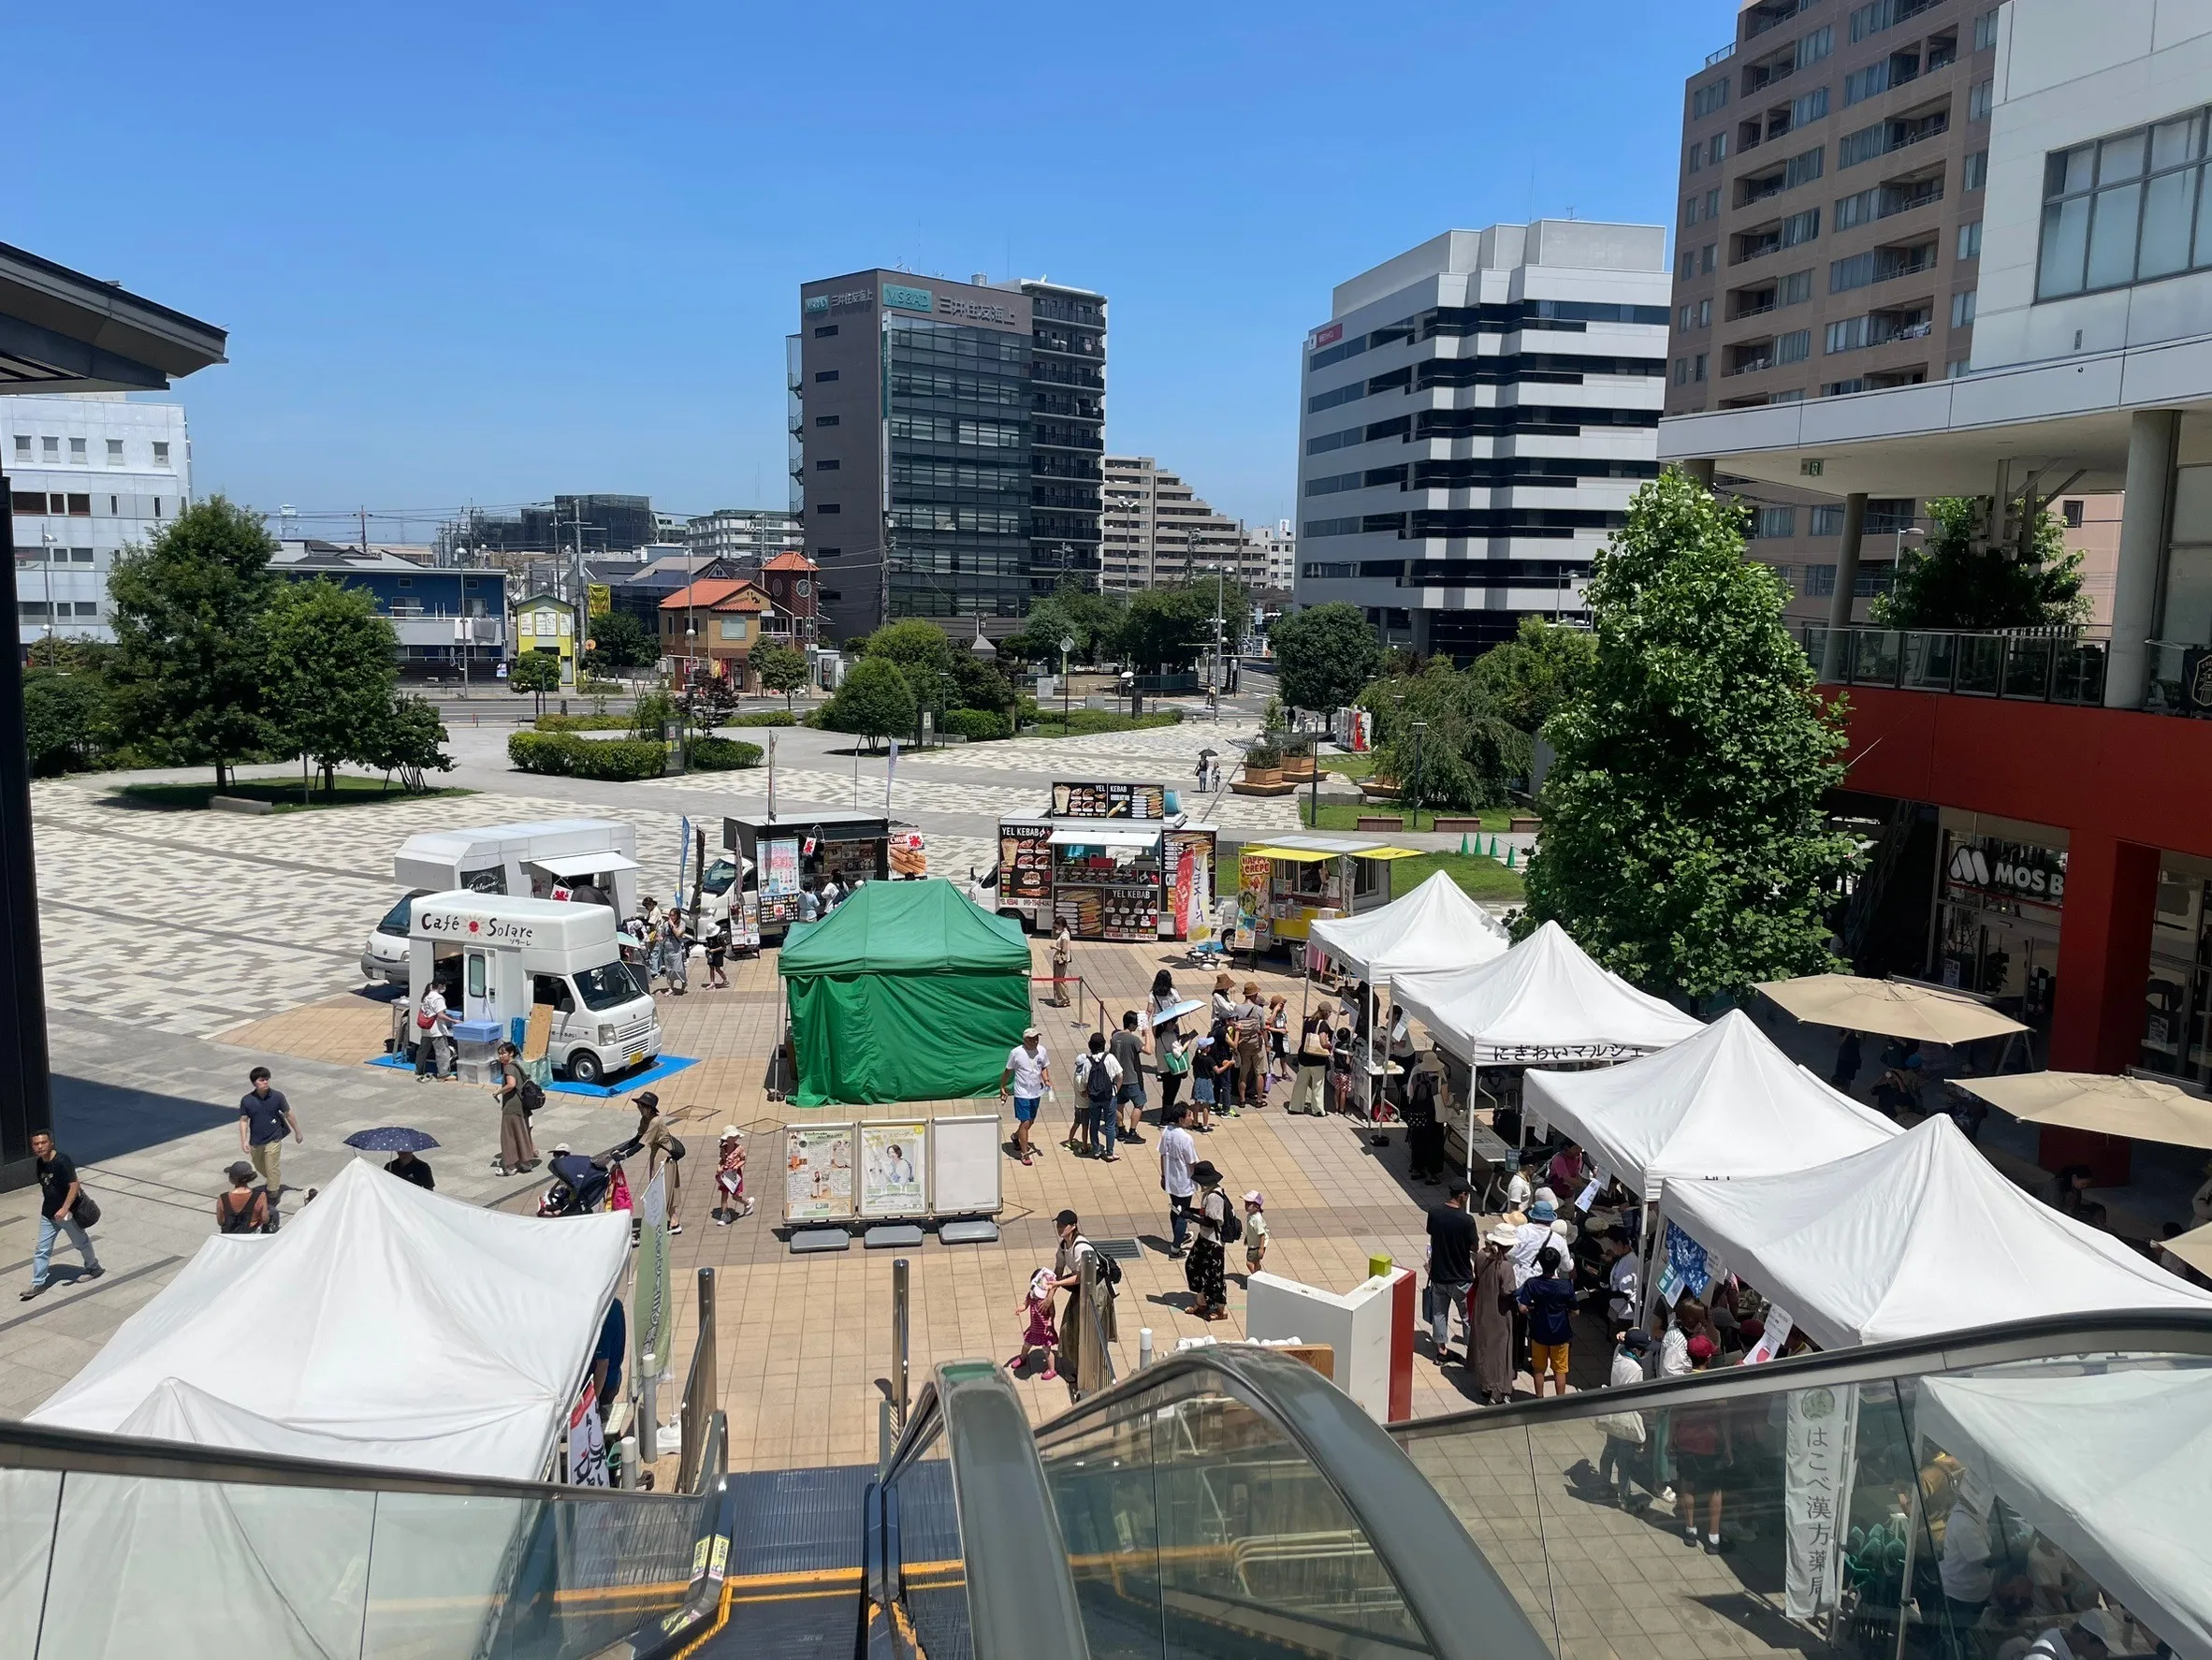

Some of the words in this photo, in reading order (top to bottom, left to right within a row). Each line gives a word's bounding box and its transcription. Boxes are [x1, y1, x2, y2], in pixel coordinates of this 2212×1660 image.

[831, 288, 873, 306] 三井住友海上
[887, 289, 929, 308] MS&AD
[939, 296, 1015, 326] 三井住友海上
[1001, 827, 1015, 836] YEL
[1016, 827, 1040, 837] KEBAB
[1245, 864, 1269, 873] CREPE
[1994, 862, 2045, 892] MOS
[1128, 890, 1151, 898] KEBAB
[421, 912, 459, 931] Café
[487, 917, 533, 938] Solare
[1493, 1043, 1644, 1061] にぎわいマルシェ
